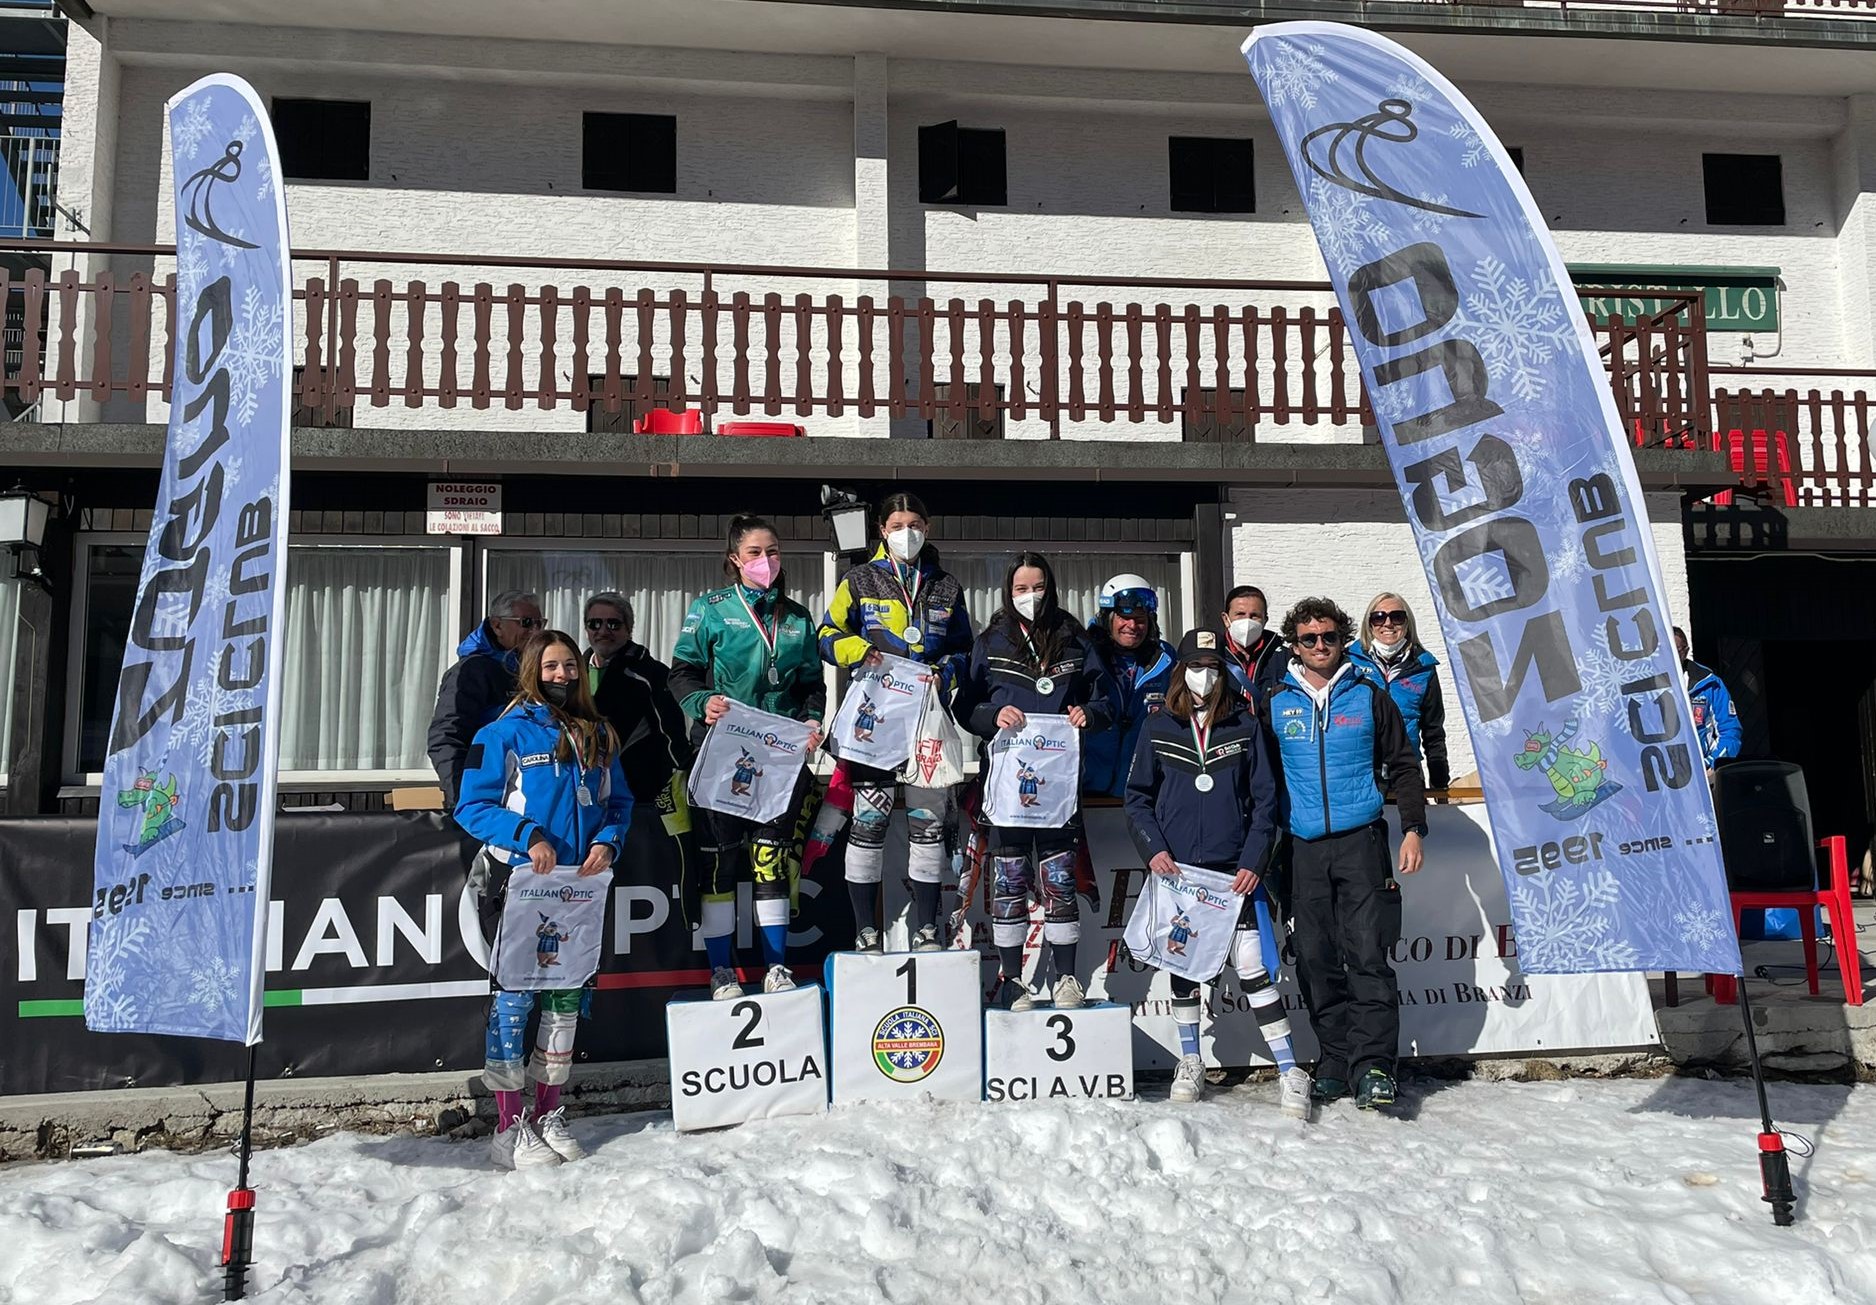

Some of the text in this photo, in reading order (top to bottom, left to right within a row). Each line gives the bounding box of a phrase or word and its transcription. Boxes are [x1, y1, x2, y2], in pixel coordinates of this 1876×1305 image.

[435, 484, 497, 494] NOLEGGIO
[443, 497, 488, 506] SDRAIO
[429, 522, 437, 532] LE
[470, 522, 479, 532] AL
[480, 522, 499, 533] SACCO
[1444, 934, 1481, 961] DI
[896, 957, 917, 1005] 1
[1424, 988, 1447, 1006] DI
[1452, 982, 1534, 1004] BRANZI
[730, 1000, 765, 1050] 2
[879, 1011, 938, 1036] SCUOLA ITALIANA SCI
[891, 1041, 908, 1049] VALLE
[1045, 1013, 1076, 1062] 3
[681, 1055, 823, 1097] SCUOLA
[986, 1076, 1038, 1101] SCI
